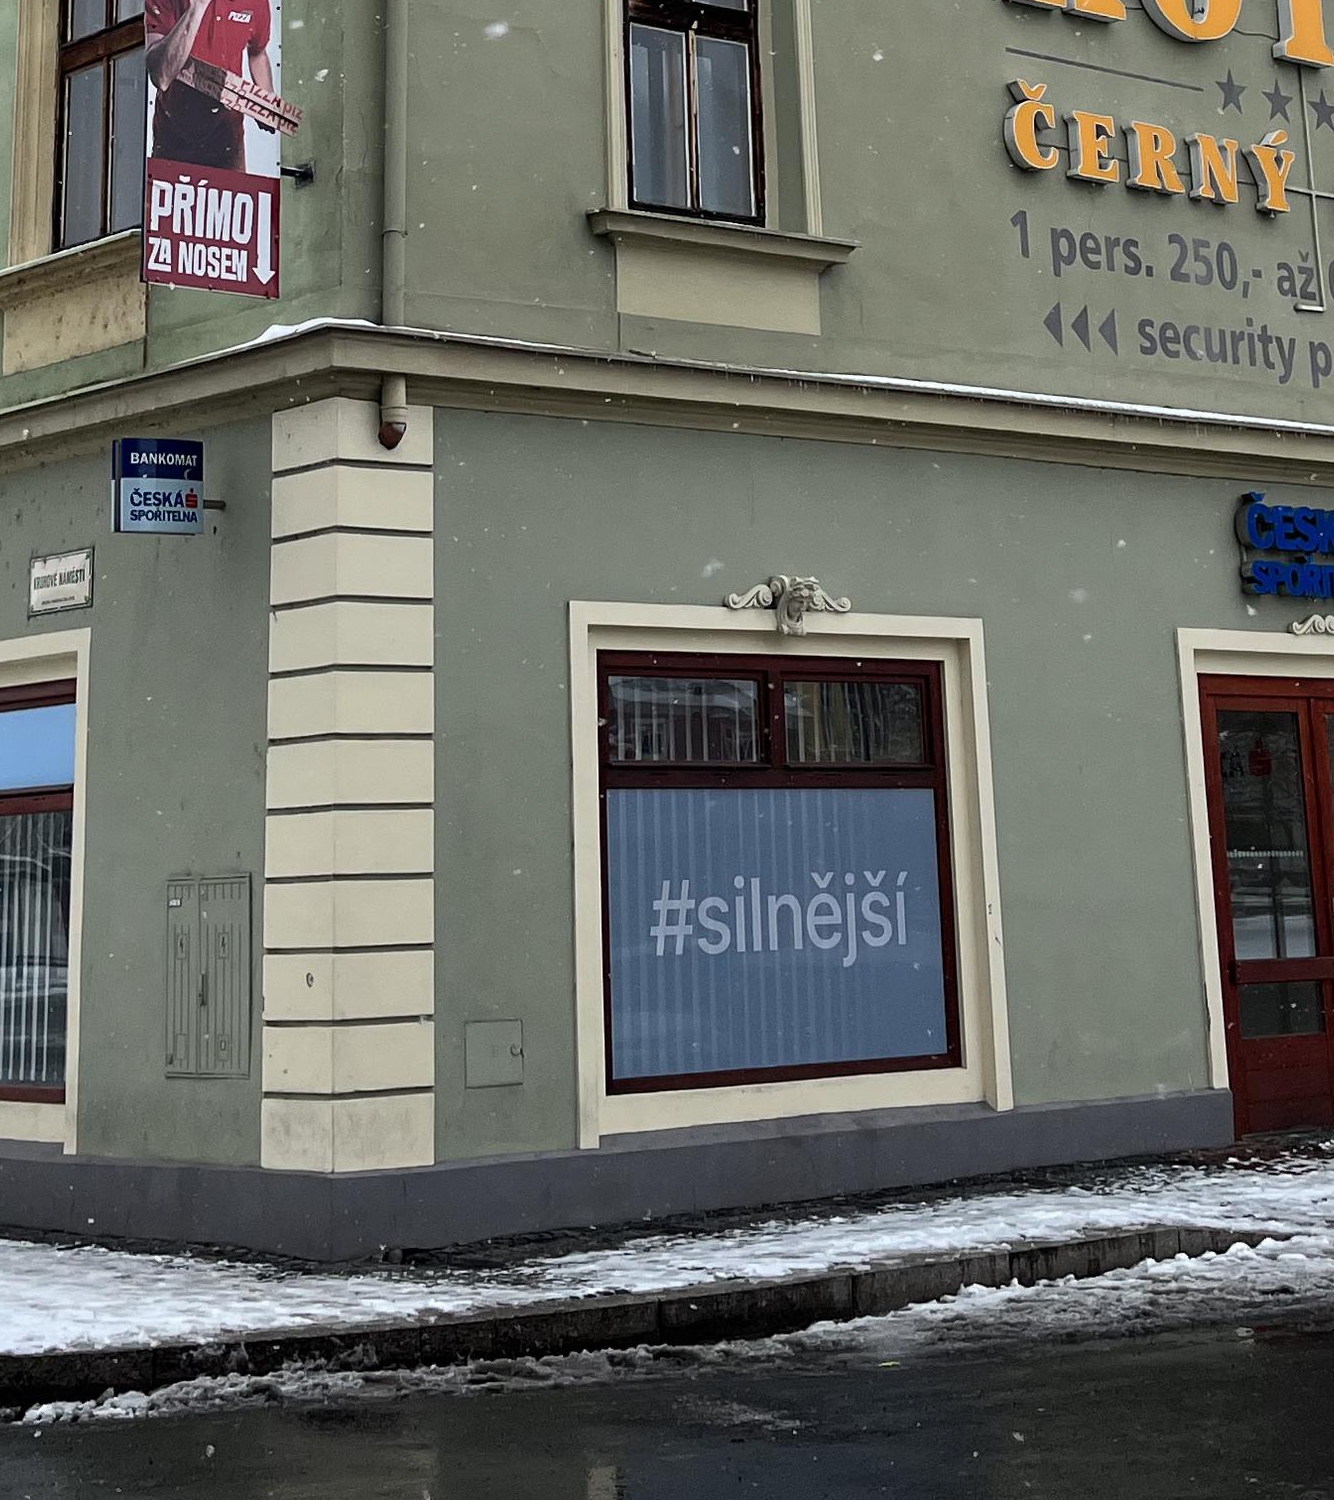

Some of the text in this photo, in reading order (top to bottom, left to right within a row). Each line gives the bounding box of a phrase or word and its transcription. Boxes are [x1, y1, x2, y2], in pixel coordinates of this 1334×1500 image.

[1005, 79, 1295, 213] ČERNÝ
[150, 175, 254, 245] PŘÍMO
[147, 236, 248, 283] ZA NOSEM
[1010, 209, 1030, 259] 1
[1050, 227, 1154, 277] pers.
[1168, 233, 1263, 299] 250,-
[1277, 250, 1318, 301] až
[1138, 317, 1296, 385] security
[130, 452, 198, 467] BANKOMAT
[129, 487, 185, 508] ČESKÁ
[129, 508, 198, 523] SPOŘITELNA
[650, 870, 908, 968] #silnější
